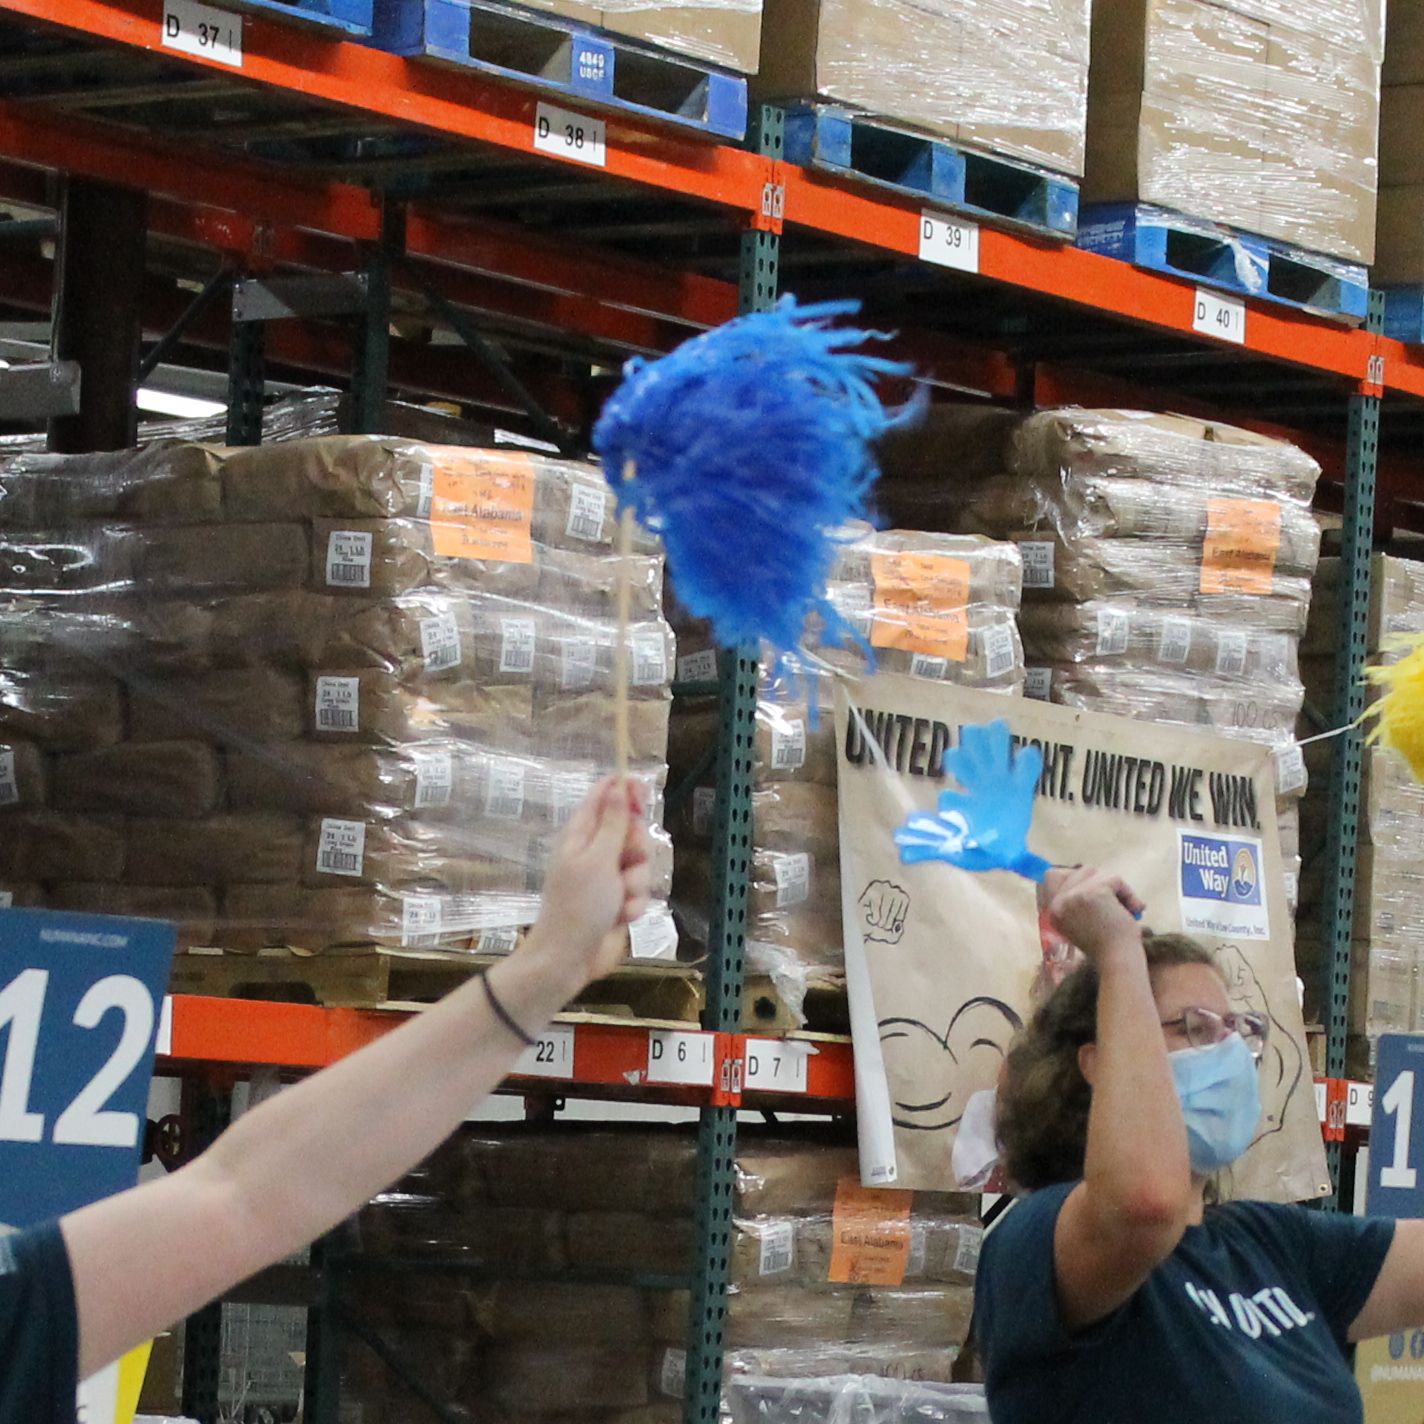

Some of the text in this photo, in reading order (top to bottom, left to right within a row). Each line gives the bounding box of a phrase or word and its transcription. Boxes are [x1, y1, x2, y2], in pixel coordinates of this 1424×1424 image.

[166, 15, 220, 47] D 37
[539, 117, 583, 149] D 38
[923, 220, 962, 249] D 39
[1197, 303, 1231, 328] D 40
[473, 503, 522, 521] Alabama
[845, 707, 949, 777] UNITED
[1082, 749, 1164, 815] UNITED
[1169, 765, 1204, 820] WE
[1209, 772, 1261, 829] WIN.
[1184, 842, 1228, 867] United
[1199, 869, 1229, 897] Way
[535, 1041, 556, 1063] 22
[651, 1039, 687, 1063] D 6
[748, 1054, 783, 1078] D 7
[1350, 1089, 1358, 1106] D
